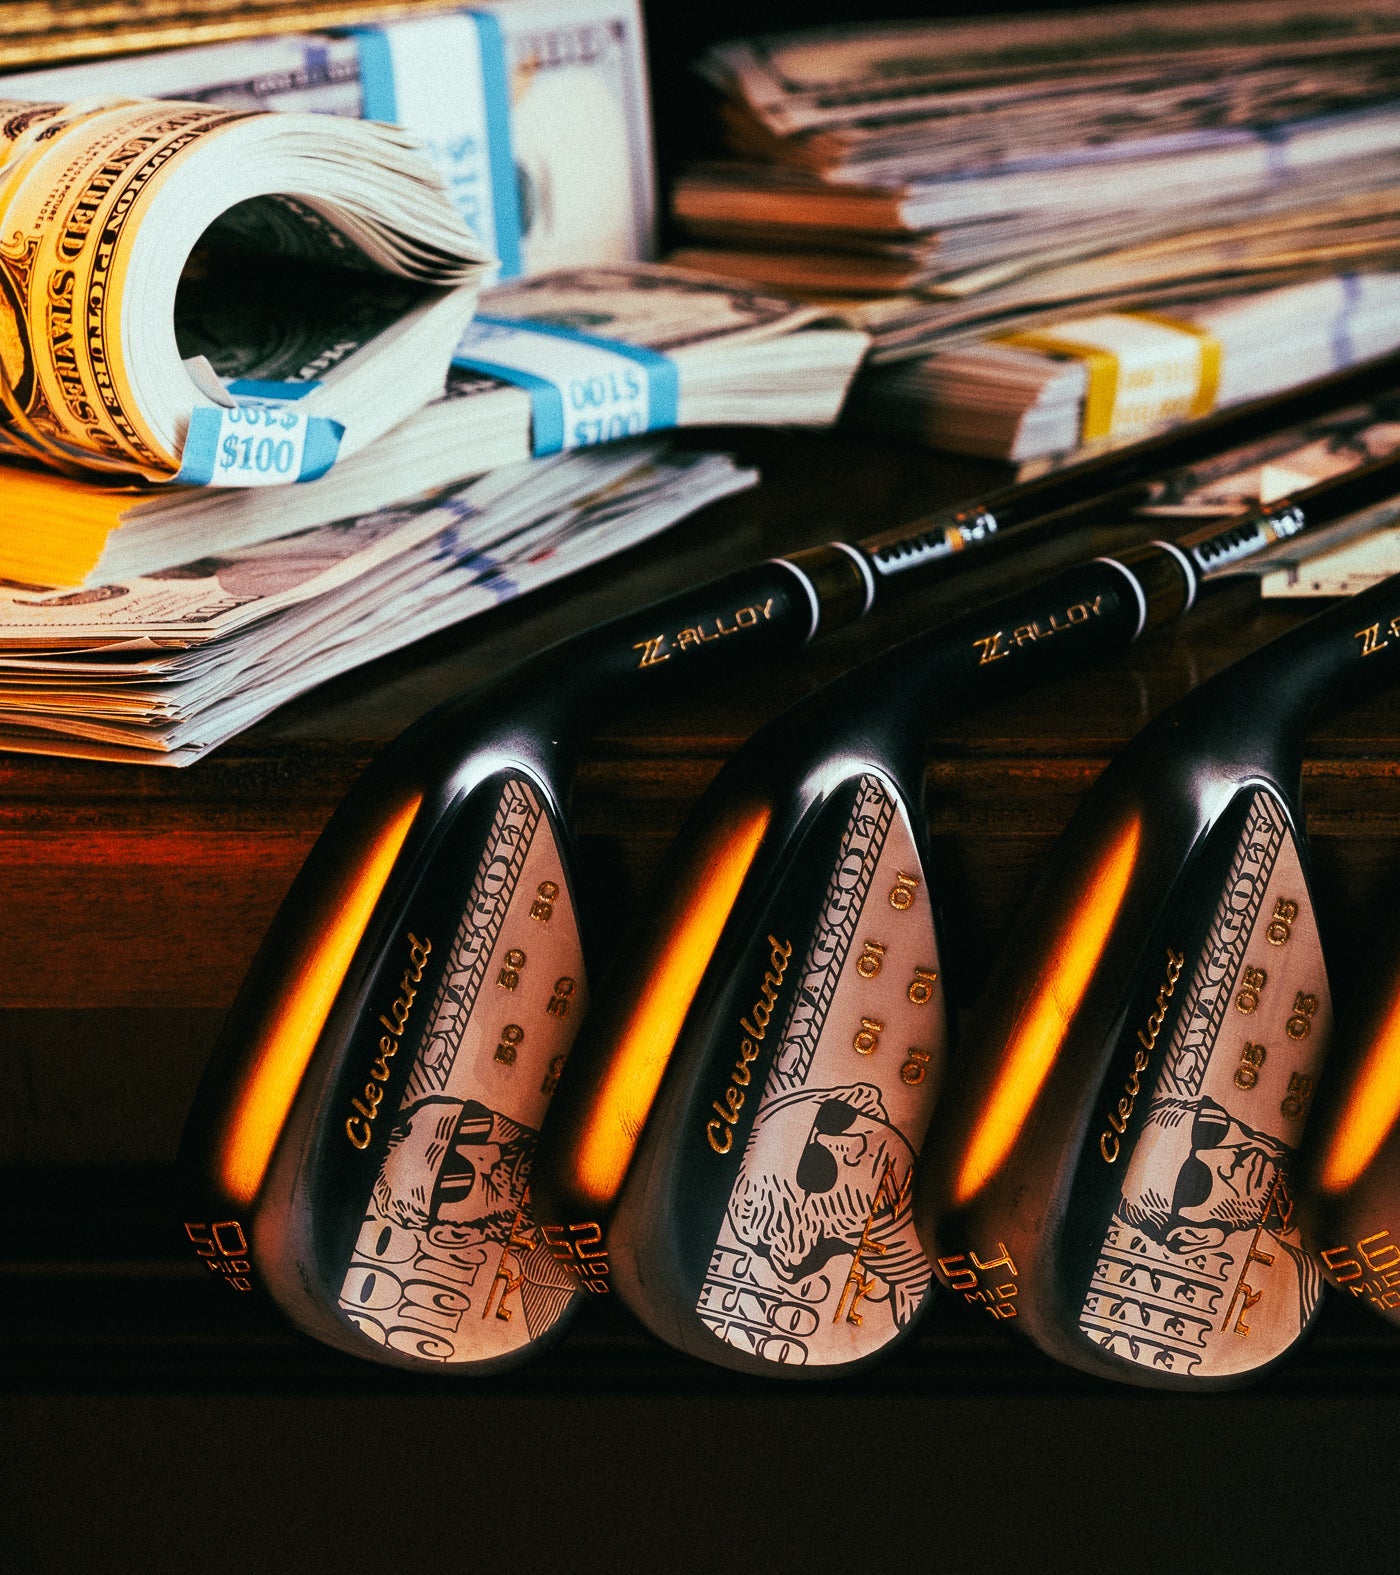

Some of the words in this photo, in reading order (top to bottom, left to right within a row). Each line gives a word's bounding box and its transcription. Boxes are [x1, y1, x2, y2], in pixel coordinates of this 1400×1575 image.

[56, 134, 159, 264] UNITED
[48, 267, 99, 426] STATES
[219, 432, 295, 474] $100
[529, 881, 559, 923] 50
[889, 871, 920, 912] 01
[1266, 896, 1299, 947] 05
[496, 948, 527, 991] 50
[855, 939, 888, 979] 01
[547, 975, 577, 1020] 50
[907, 965, 938, 1005] 01
[1234, 964, 1268, 1015] 05
[852, 1016, 884, 1056] 01
[1285, 990, 1319, 1040] 05
[346, 932, 433, 1150] Cleveland
[494, 1023, 525, 1066] 50
[706, 934, 793, 1154] Cleveland
[1100, 947, 1185, 1163] Cleveland
[1232, 1041, 1267, 1090] 05
[184, 1220, 248, 1258] 50
[541, 1221, 609, 1260] 52
[206, 1258, 250, 1274] MID
[224, 1275, 252, 1292] 10
[563, 1261, 610, 1278] MID
[580, 1278, 610, 1294] 10
[937, 1241, 1019, 1290] 54
[963, 1282, 1019, 1305] MID
[985, 1301, 1018, 1320] 10
